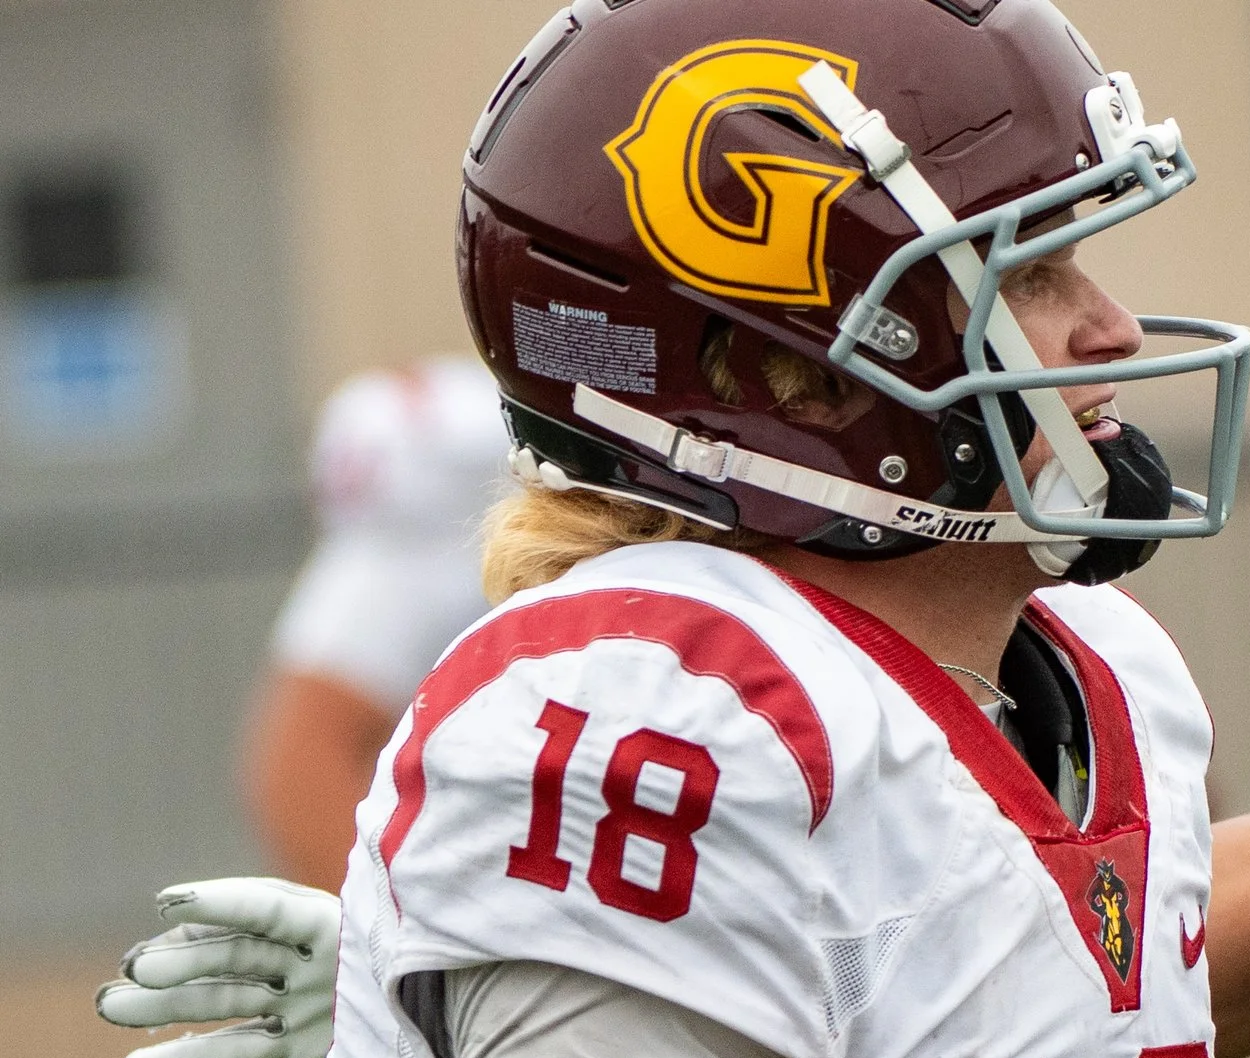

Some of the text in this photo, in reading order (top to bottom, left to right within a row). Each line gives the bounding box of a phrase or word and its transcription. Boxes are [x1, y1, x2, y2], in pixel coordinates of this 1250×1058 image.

[602, 39, 863, 307] G
[548, 301, 608, 323] WARNING
[506, 698, 719, 922] 18
